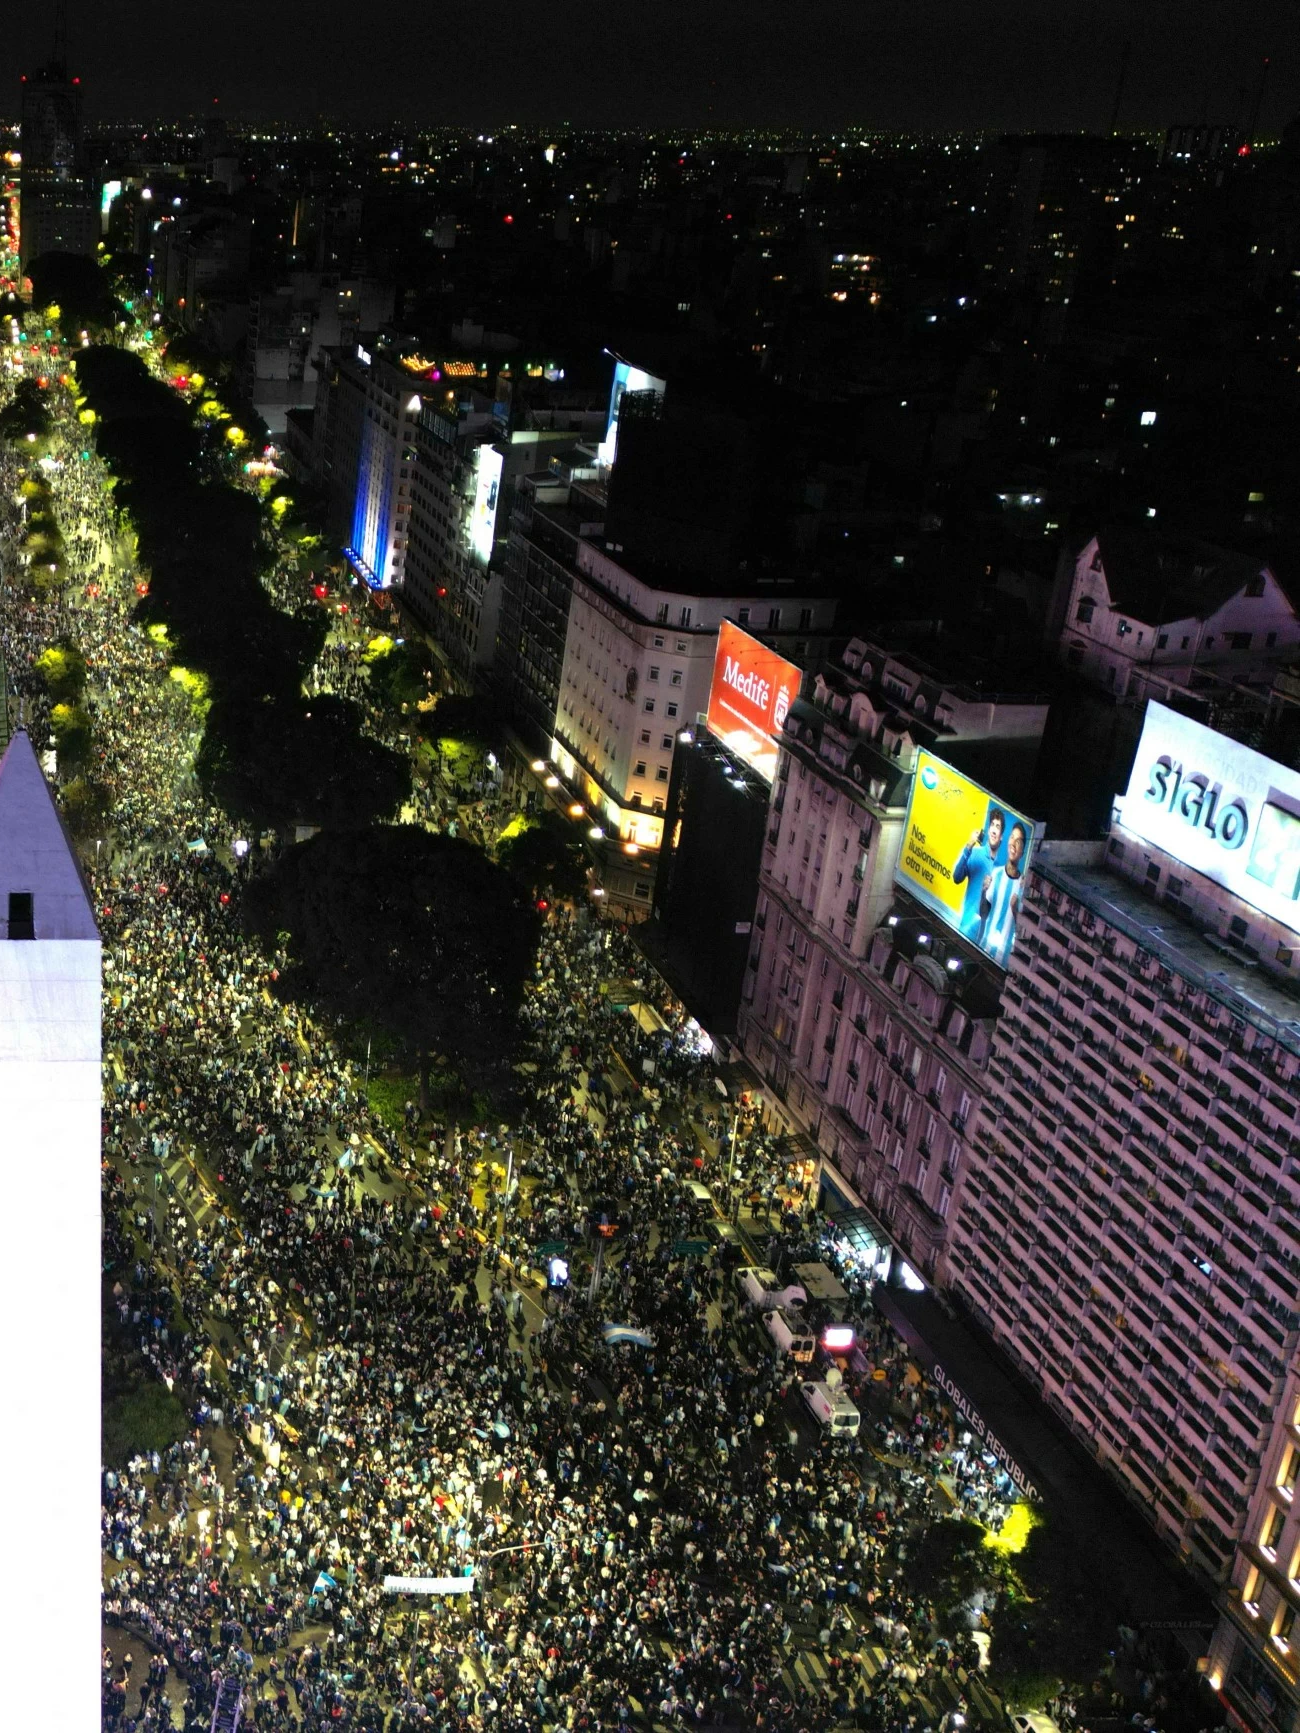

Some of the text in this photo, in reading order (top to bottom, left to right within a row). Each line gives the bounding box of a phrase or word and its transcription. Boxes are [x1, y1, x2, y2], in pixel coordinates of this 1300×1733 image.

[722, 656, 770, 711] Medifé
[1144, 760, 1248, 850] SIGLO
[908, 837, 952, 880] ilusionamos
[911, 823, 927, 845] Nos
[905, 855, 935, 884] otra vez
[933, 1363, 986, 1437] GLOBALES
